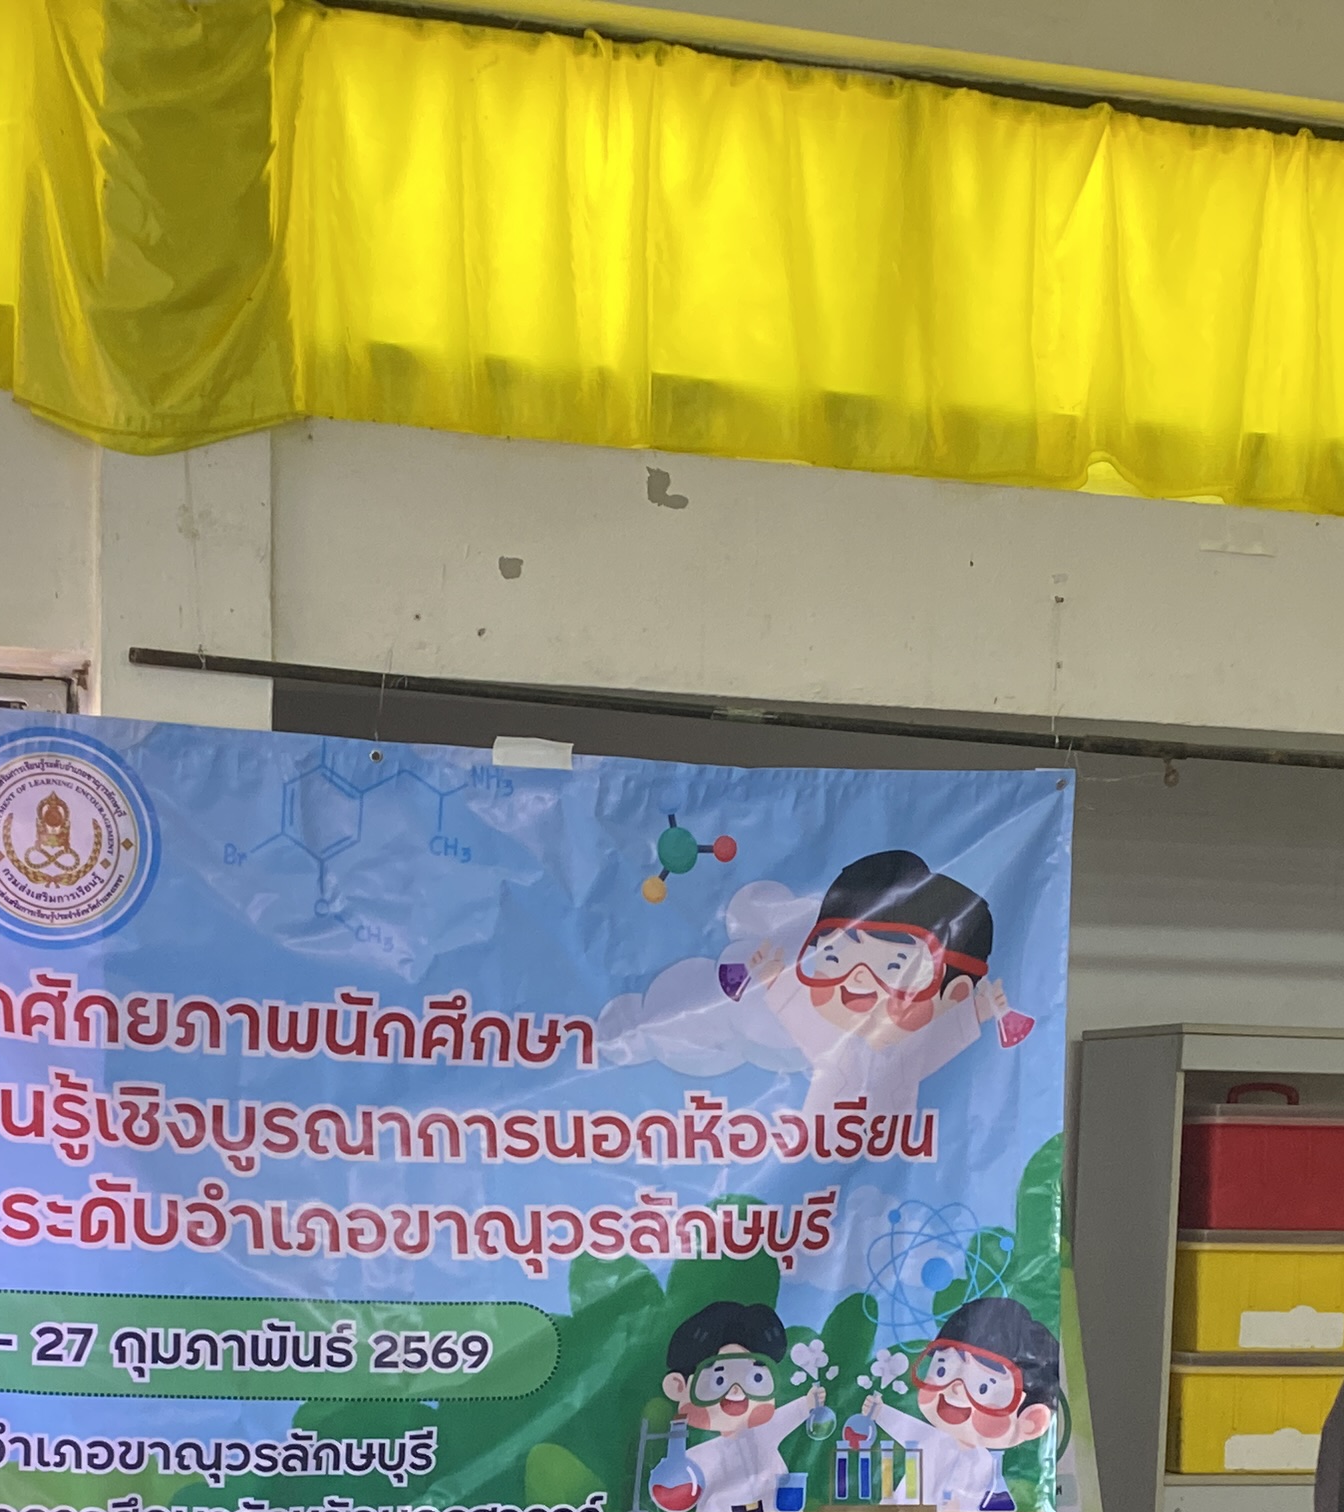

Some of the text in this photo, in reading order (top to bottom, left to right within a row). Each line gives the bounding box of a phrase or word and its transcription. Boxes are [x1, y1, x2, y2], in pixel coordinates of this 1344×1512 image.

[17, 783, 26, 795] OF
[28, 778, 74, 790] LEARNING
[75, 785, 114, 856] ENCOURAGEMENT
[33, 1325, 94, 1365] 27
[114, 1318, 354, 1374] กุมภาพันธ์
[373, 1334, 490, 1370] 2569
